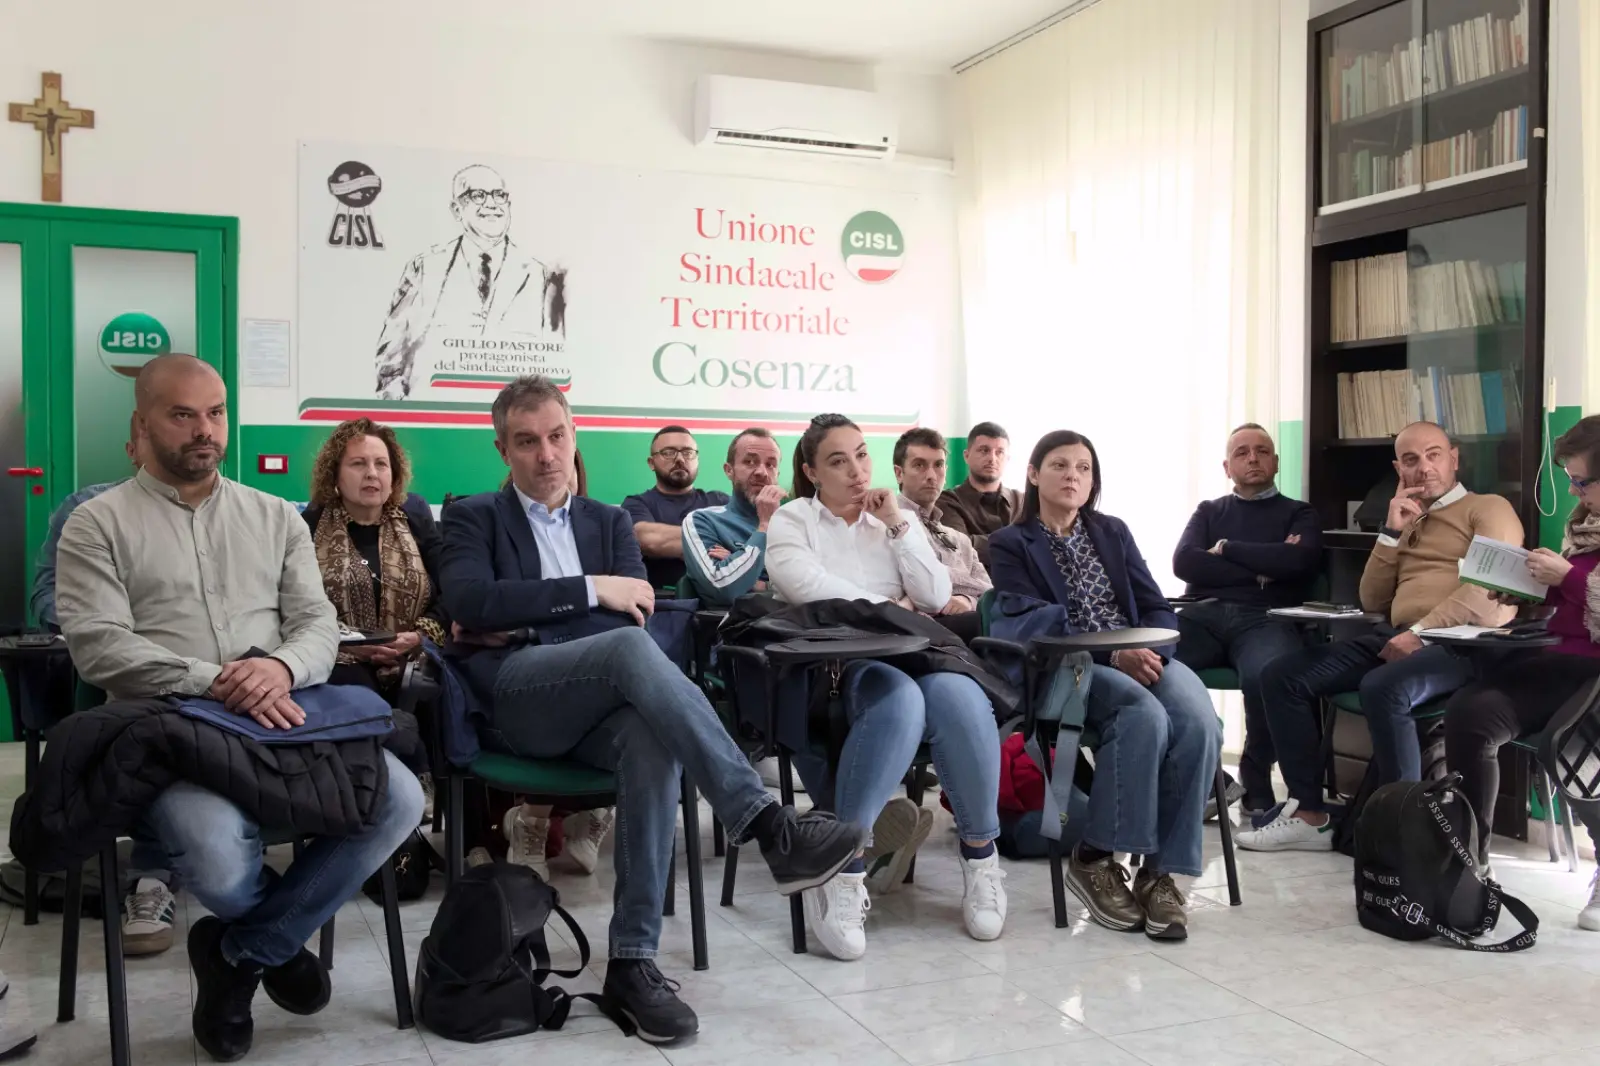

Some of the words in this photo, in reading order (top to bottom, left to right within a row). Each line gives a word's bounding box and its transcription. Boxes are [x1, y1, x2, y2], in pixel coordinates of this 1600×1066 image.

[328, 213, 383, 248] CISL
[694, 207, 815, 246] Unione
[849, 231, 898, 250] CISL
[680, 252, 835, 291] Sindacale
[660, 296, 850, 336] Territoriale
[442, 338, 497, 349] GIULIO
[500, 340, 565, 352] PASTORE
[459, 351, 545, 363] protagonista
[434, 360, 456, 371] del
[460, 361, 525, 374] sindacato
[529, 366, 570, 375] nuovo
[652, 341, 857, 392] Cosenza
[1428, 801, 1452, 833] GUESS
[1450, 836, 1473, 867] GUESS
[1436, 924, 1467, 946] GUESS
